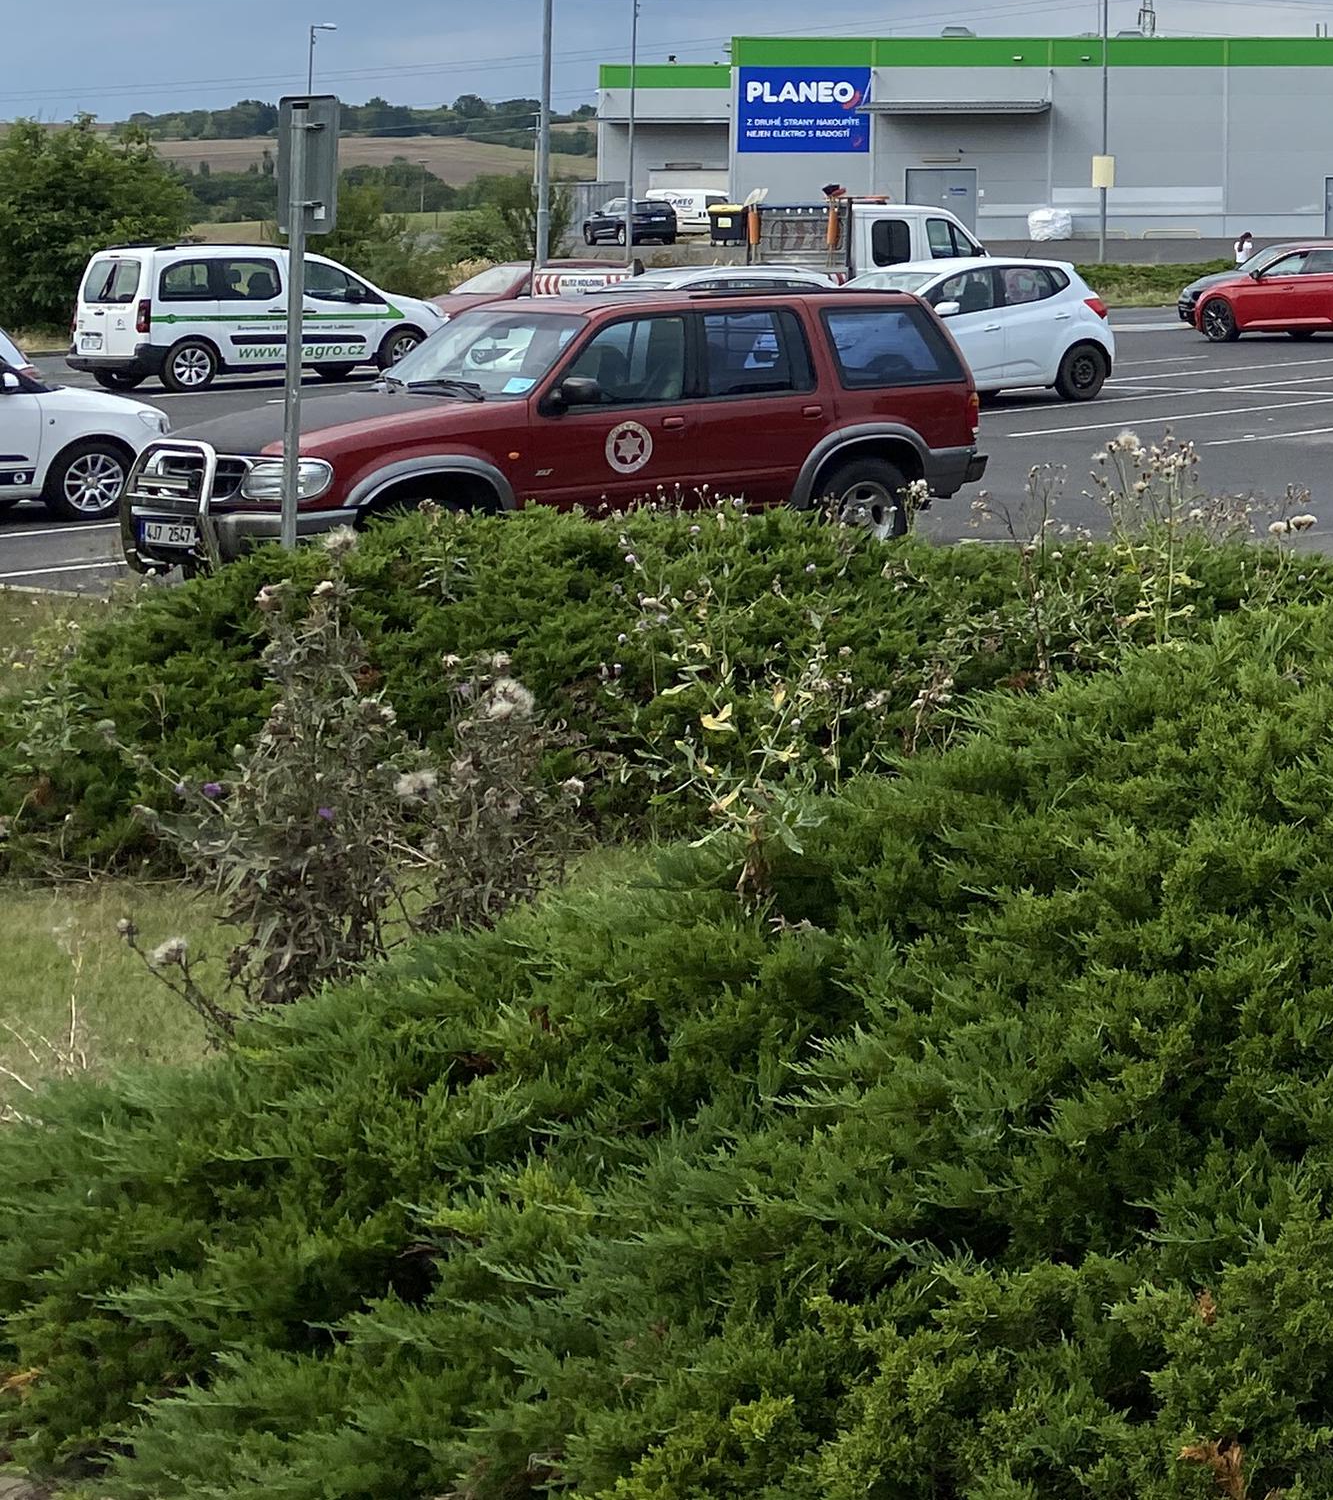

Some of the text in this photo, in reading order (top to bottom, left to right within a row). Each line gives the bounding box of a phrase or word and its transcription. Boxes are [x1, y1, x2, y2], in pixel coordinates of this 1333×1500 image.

[746, 81, 855, 103] PLANEO
[783, 118, 814, 126] STRANY
[746, 128, 850, 138] NEJEN ELEKTRO S RADOSTÍ
